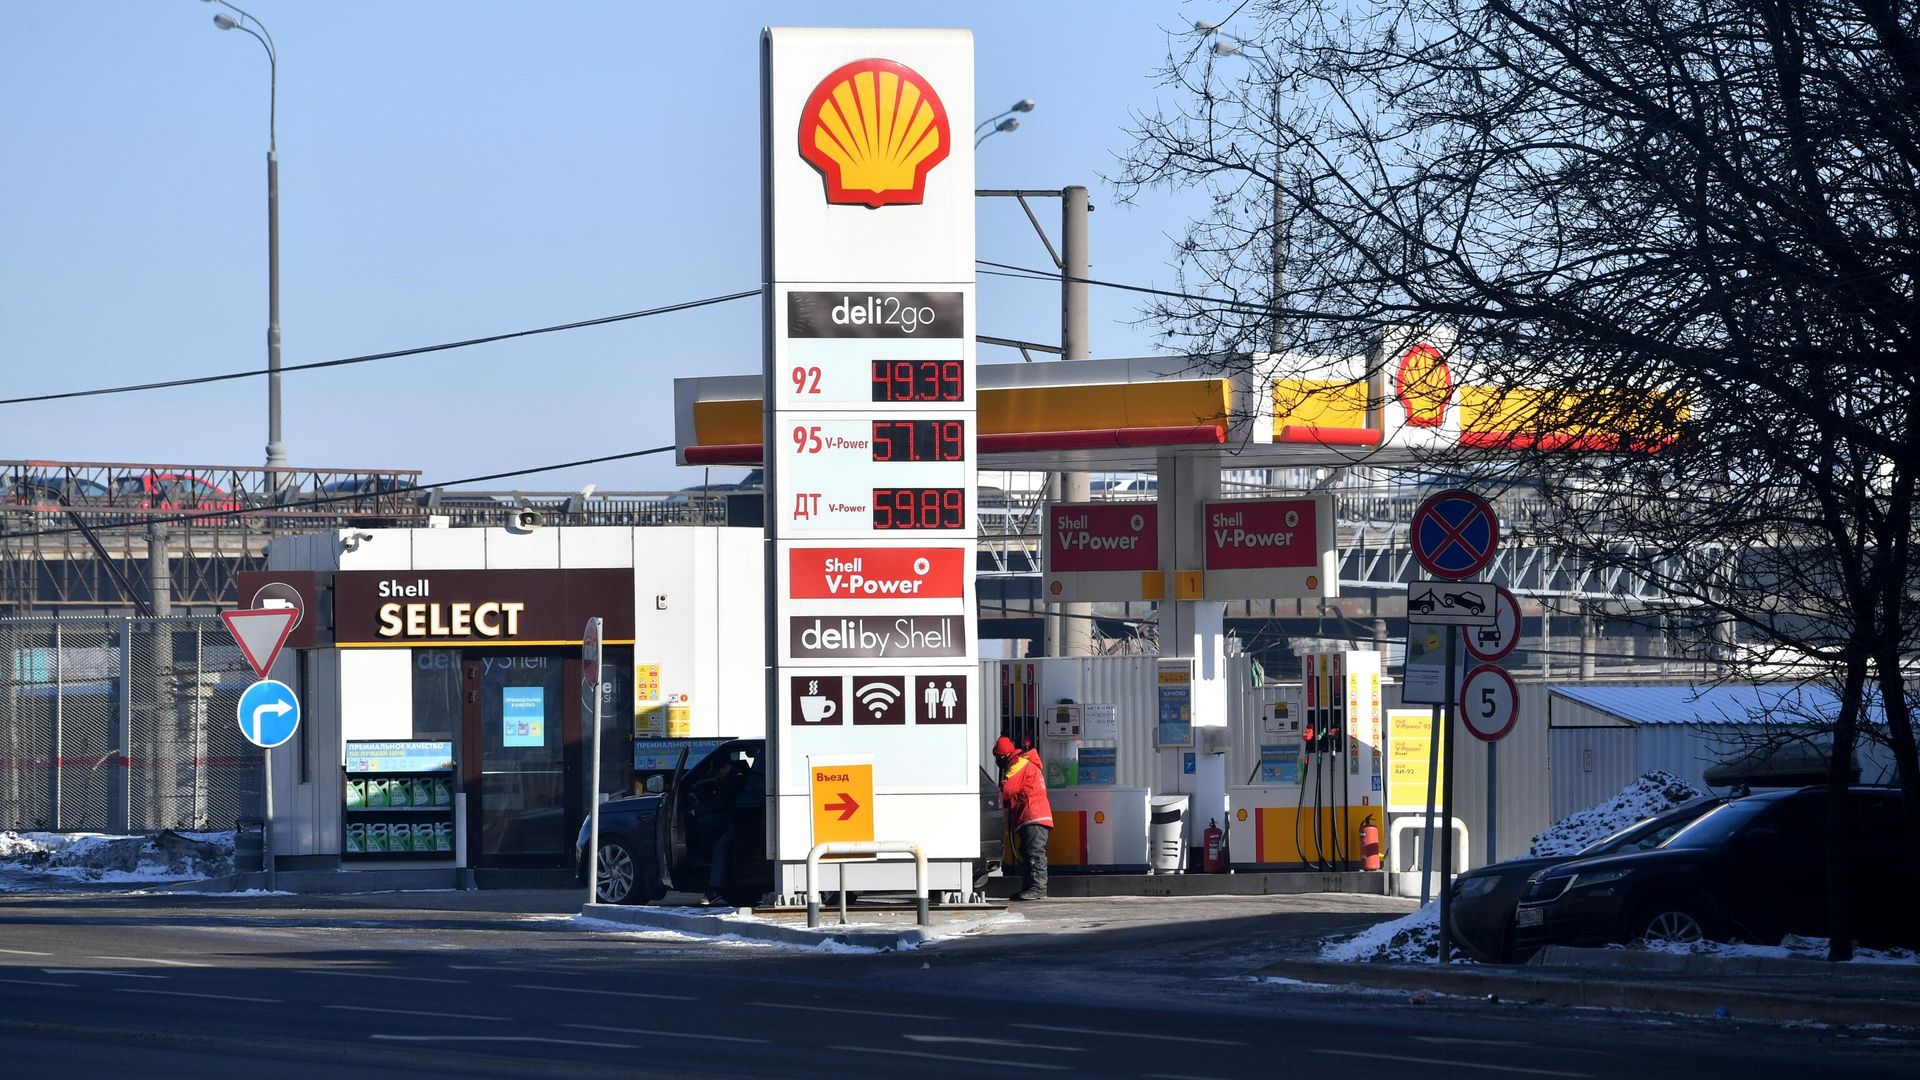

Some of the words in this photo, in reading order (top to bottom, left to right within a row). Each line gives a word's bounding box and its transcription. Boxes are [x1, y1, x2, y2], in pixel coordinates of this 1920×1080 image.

[832, 296, 935, 333] deli2go
[792, 366, 822, 394] 92
[872, 361, 961, 401] 49.39
[793, 426, 823, 454] 95
[826, 437, 869, 450] V-Power
[873, 422, 962, 461] 57.19
[794, 493, 822, 521] ДТ
[829, 503, 866, 513] V-Power
[873, 489, 962, 528] 59.89
[1058, 515, 1088, 530] Shell
[1212, 512, 1243, 527] Shell
[1058, 531, 1138, 550] V-Power
[1214, 529, 1294, 548] V-Power
[825, 558, 862, 573] Shell
[378, 579, 429, 597] Shell
[825, 574, 922, 594] V-Power
[1190, 577, 1196, 593] 1
[378, 602, 525, 637] SELECT
[801, 619, 856, 649] deli
[894, 618, 952, 649] Shell
[1481, 688, 1496, 718] 5
[636, 741, 692, 749] ПРЕМИАЛЬНОЕ
[693, 740, 723, 748] КАЧЕСТ
[816, 772, 850, 783] Въезд
